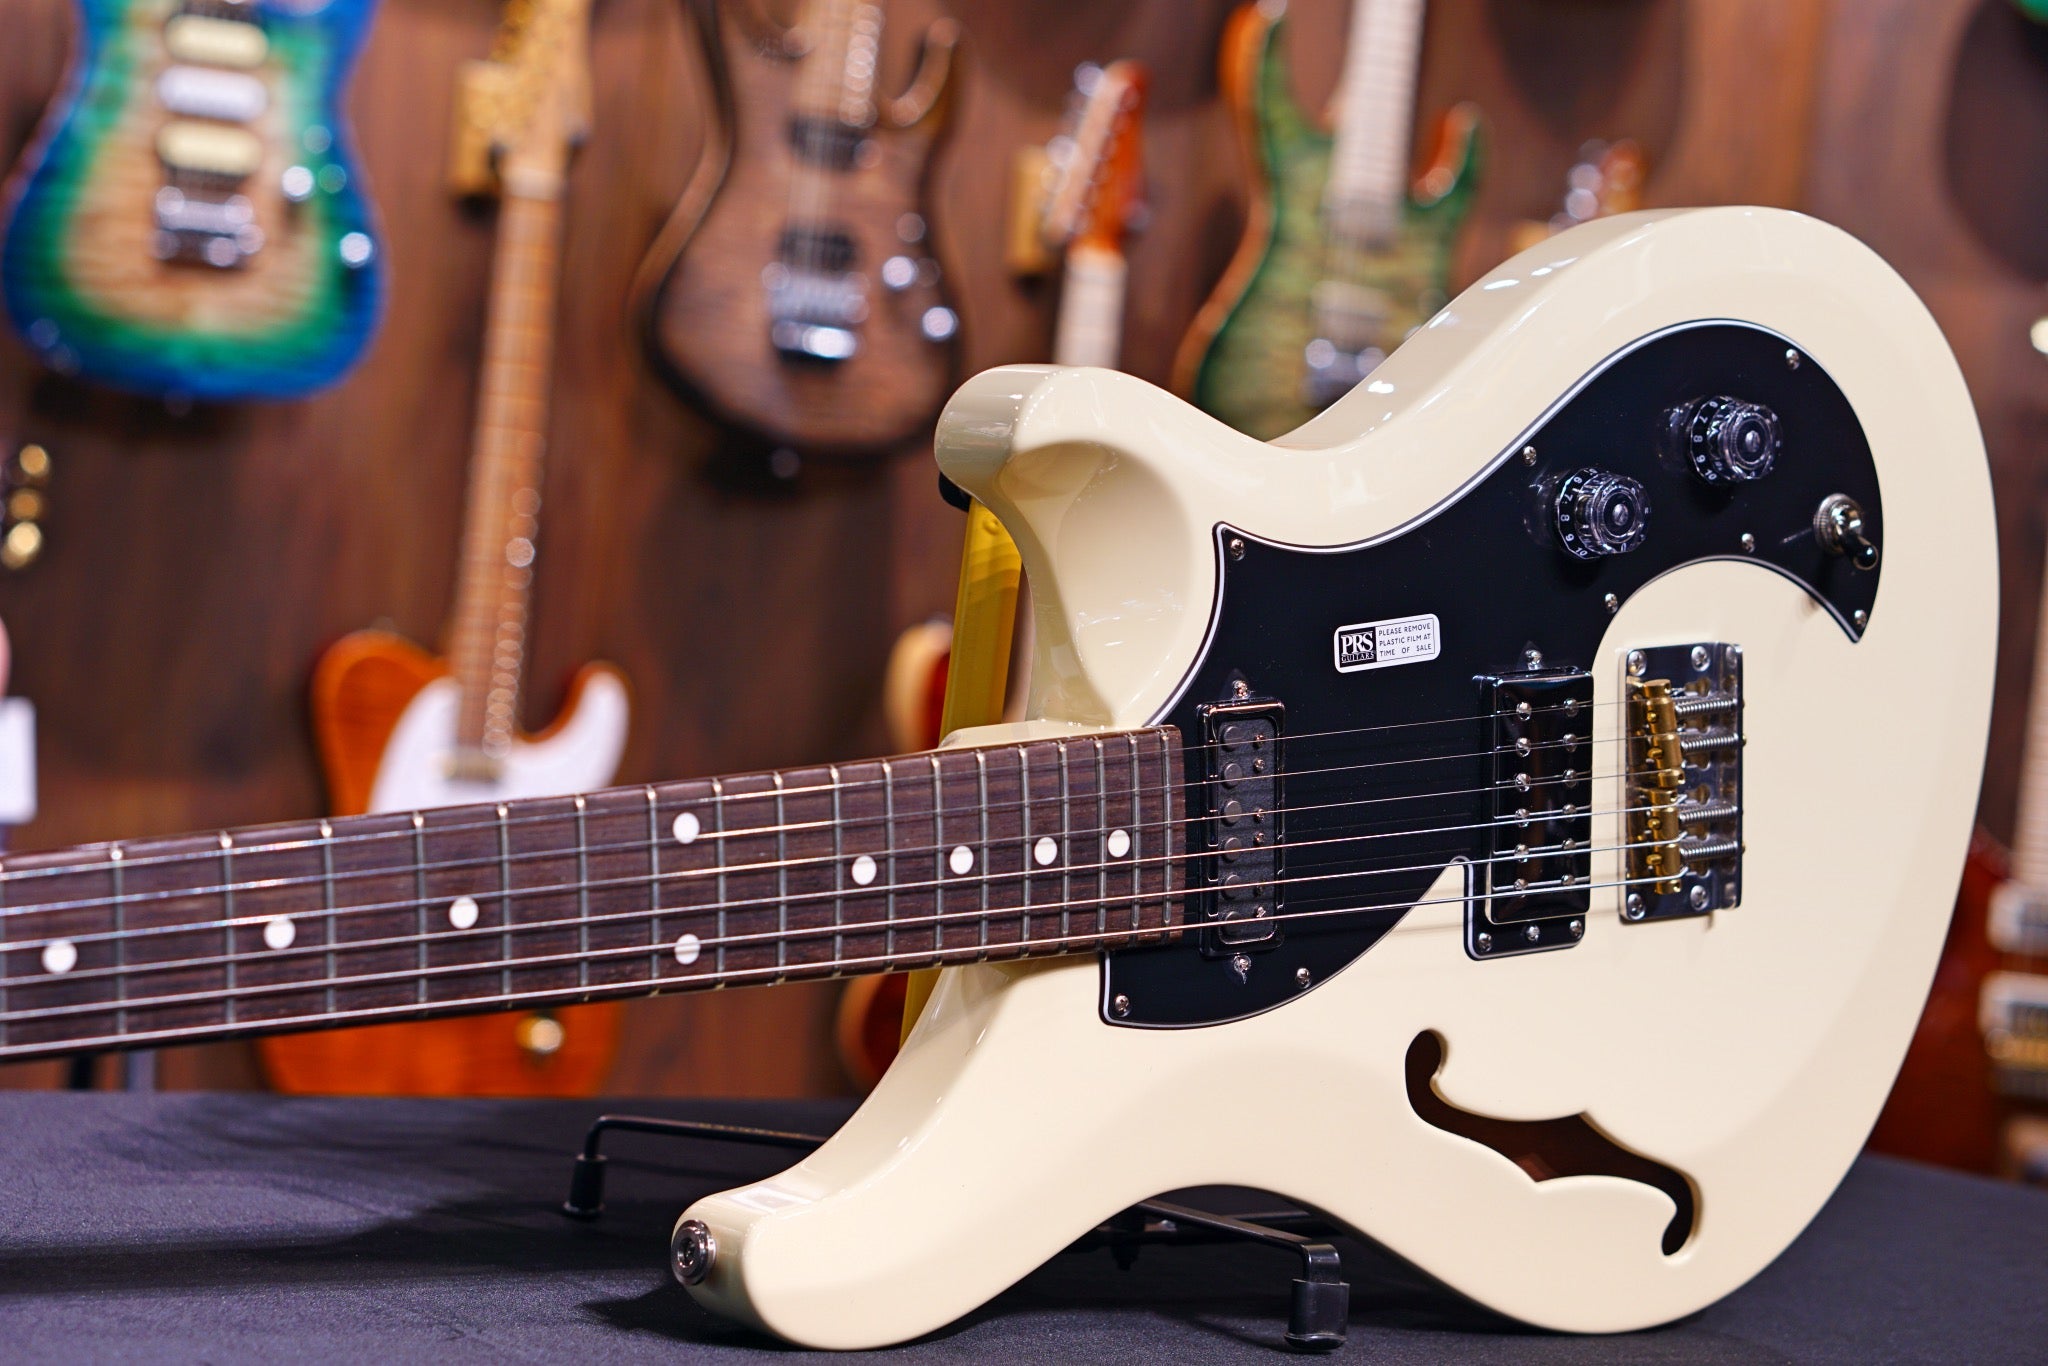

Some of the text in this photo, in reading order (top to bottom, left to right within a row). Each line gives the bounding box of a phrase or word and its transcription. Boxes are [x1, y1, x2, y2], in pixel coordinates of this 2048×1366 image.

[1699, 416, 1708, 424] 7
[1693, 435, 1703, 443] 8
[1696, 454, 1705, 463] 9
[1704, 469, 1717, 480] 10
[1573, 476, 1582, 484] 6
[1564, 493, 1573, 501] 7
[1560, 514, 1570, 522] 8
[1565, 533, 1574, 542] 9
[1575, 547, 1588, 556] 10
[1379, 623, 1431, 636] PLEASE REMOVE
[1341, 631, 1374, 654] PRS
[1379, 637, 1405, 646] PLASTIC
[1341, 652, 1374, 662] GUITARS
[1380, 649, 1395, 657] TIME
